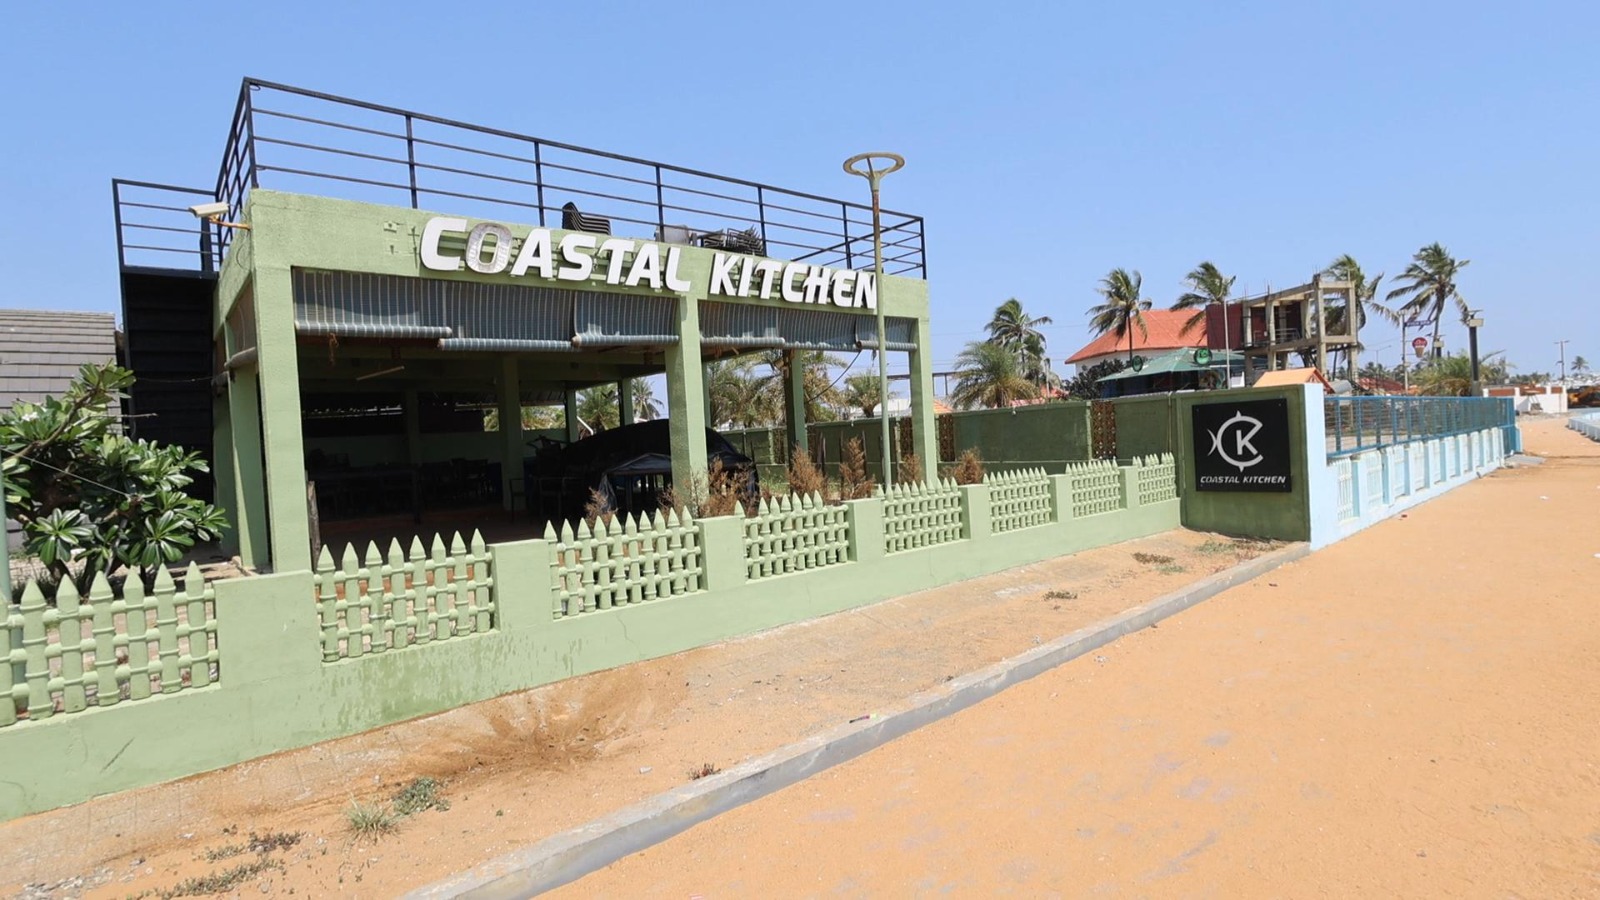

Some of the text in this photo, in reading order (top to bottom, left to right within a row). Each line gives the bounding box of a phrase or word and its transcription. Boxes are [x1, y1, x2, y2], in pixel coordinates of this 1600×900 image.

[420, 216, 878, 309] COASTAL KITCHEN
[1200, 475, 1286, 483] COASTAL KITCHEN
